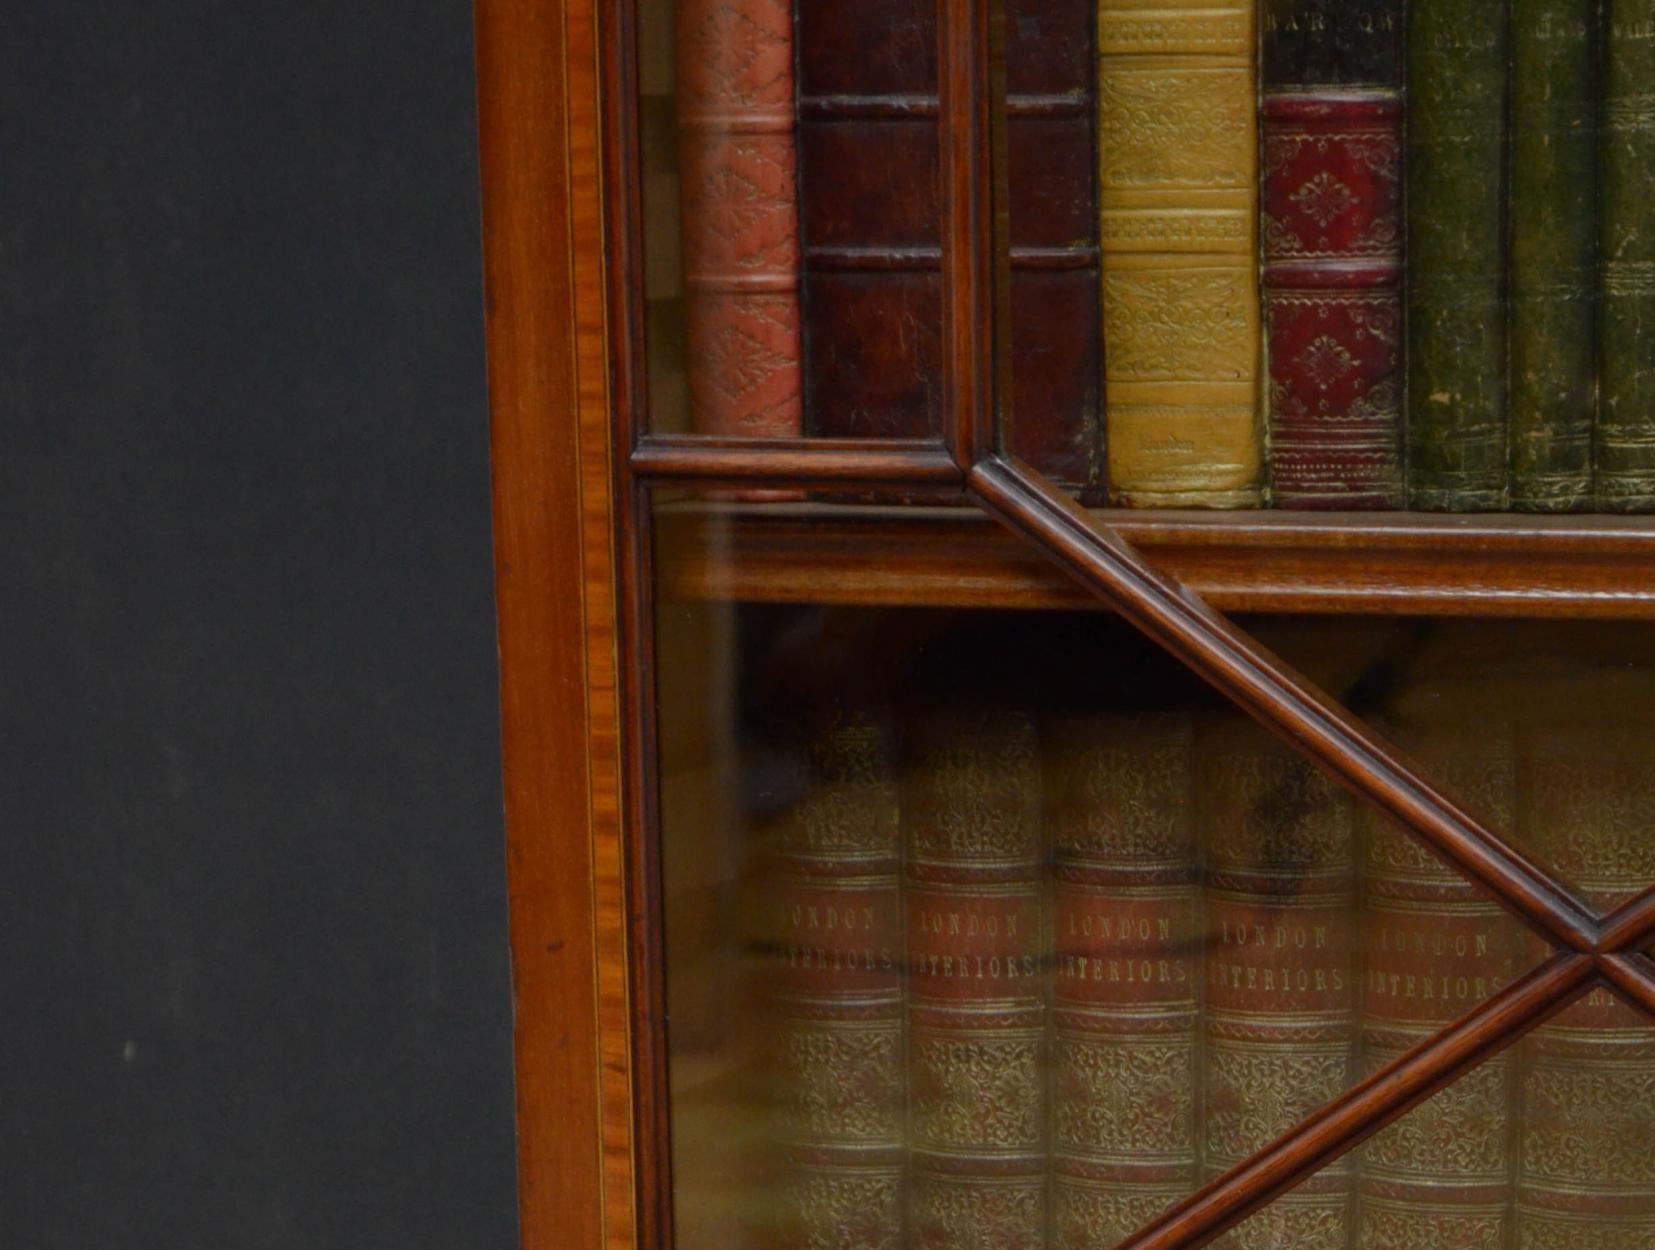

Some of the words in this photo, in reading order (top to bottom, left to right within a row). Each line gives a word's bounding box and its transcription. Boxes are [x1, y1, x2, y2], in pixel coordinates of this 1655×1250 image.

[783, 905, 876, 931] ONDON
[919, 911, 1018, 937] LONDON
[1069, 912, 1170, 940] LONDON
[1221, 920, 1327, 949] LONDON
[1376, 926, 1488, 956] LONDON
[772, 945, 892, 970] TERIORS
[911, 950, 1034, 978] NTERIORS
[1058, 953, 1186, 982] INTERIORS
[1368, 966, 1502, 999] INTERIORS
